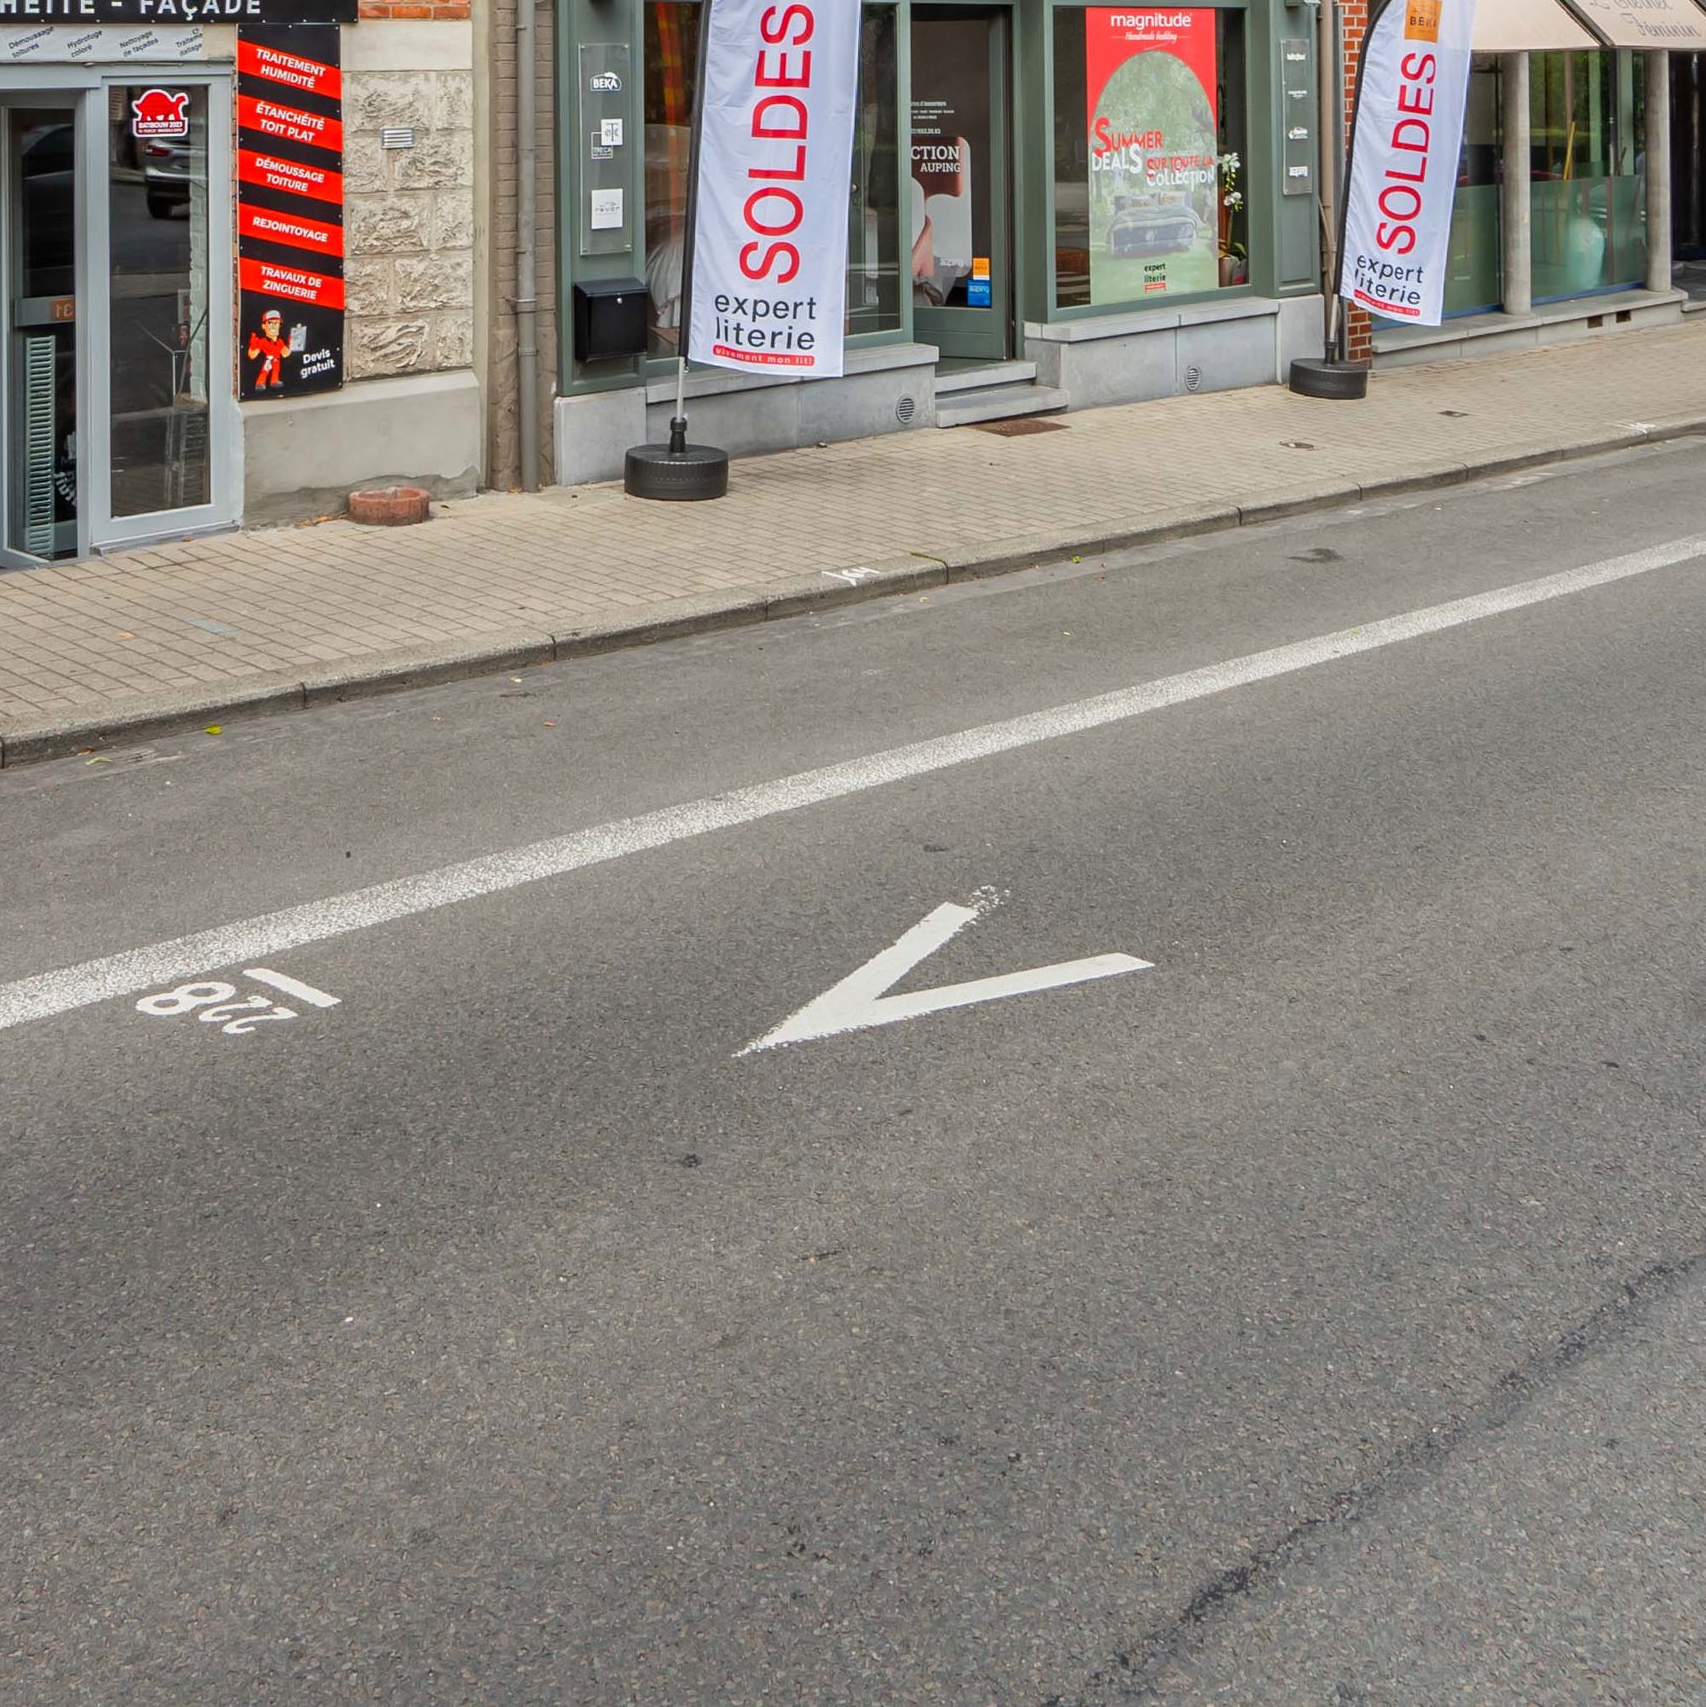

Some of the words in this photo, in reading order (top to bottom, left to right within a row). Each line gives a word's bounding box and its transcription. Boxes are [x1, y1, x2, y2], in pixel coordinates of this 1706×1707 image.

[1111, 13, 1191, 30] magnitude
[256, 48, 326, 77] TRAITEMENT
[260, 65, 316, 89] HUMIDITÉ
[593, 78, 618, 89] BEKA
[255, 101, 325, 131] ÉTANCHÉITÉ
[260, 119, 286, 135] TOIT
[287, 127, 315, 142] PLAT
[739, 3, 815, 284] SOLDES
[911, 146, 960, 160] CTION
[1376, 52, 1437, 255] SOLDES
[255, 157, 325, 183] DÉMOUSSAGE
[920, 162, 961, 173] AUPING
[1092, 144, 1142, 174] DEALS
[266, 173, 309, 192] TOITURE
[252, 216, 328, 243] REJOINTOYAGE
[260, 266, 306, 285] TRAVAUX
[308, 276, 322, 288] DE
[1357, 255, 1423, 283] expert
[262, 280, 317, 300] ZINGUERIE
[1355, 268, 1421, 305] literie
[714, 294, 817, 322] expert
[715, 316, 815, 351] literie
[302, 348, 331, 364] Devis
[767, 356, 791, 364] mon
[300, 358, 336, 379] gratuit
